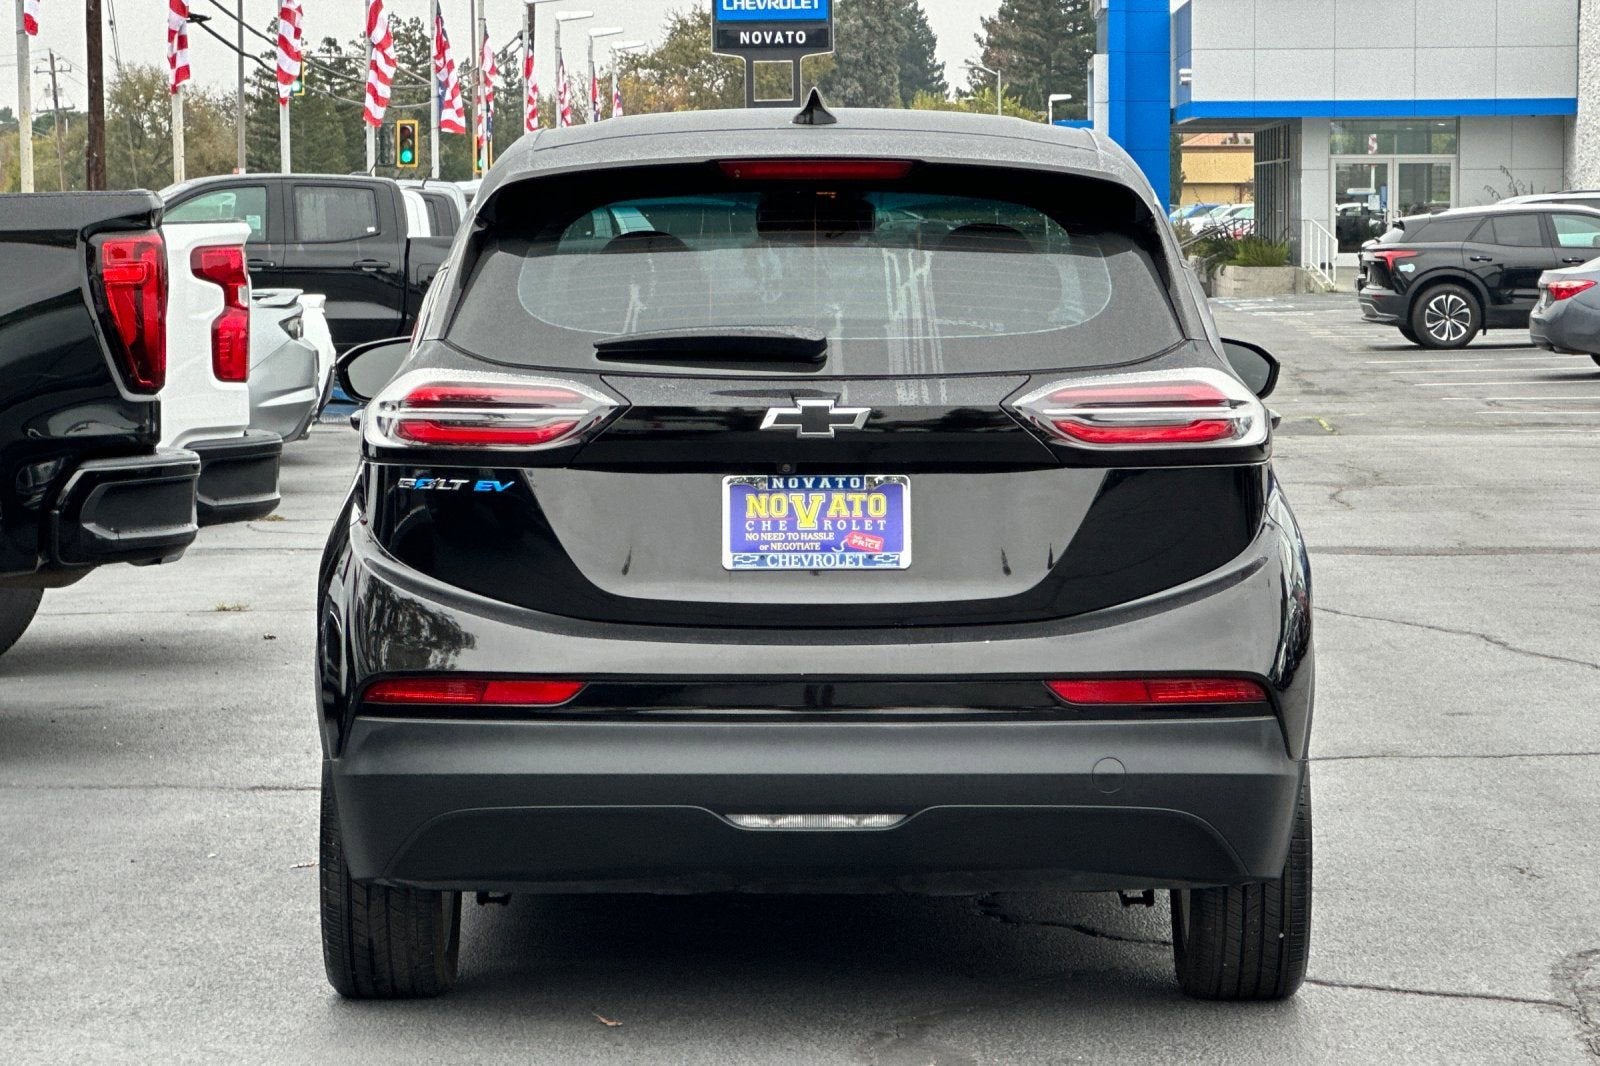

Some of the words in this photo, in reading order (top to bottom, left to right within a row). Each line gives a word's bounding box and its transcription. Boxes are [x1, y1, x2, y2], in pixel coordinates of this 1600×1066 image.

[722, 0, 819, 10] CHEVROLET
[740, 31, 807, 44] NOVATO
[397, 477, 470, 490] BOLT
[473, 480, 515, 492] EV
[771, 477, 861, 489] NOVATO
[745, 493, 887, 530] NOVATO
[745, 532, 759, 541] NO
[760, 532, 785, 540] NEED
[786, 532, 799, 540] TO
[800, 532, 835, 540] HASSLE
[770, 542, 821, 551] NEGOTIATE
[851, 537, 881, 551] PRICE
[766, 553, 867, 567] CHEVROLET
